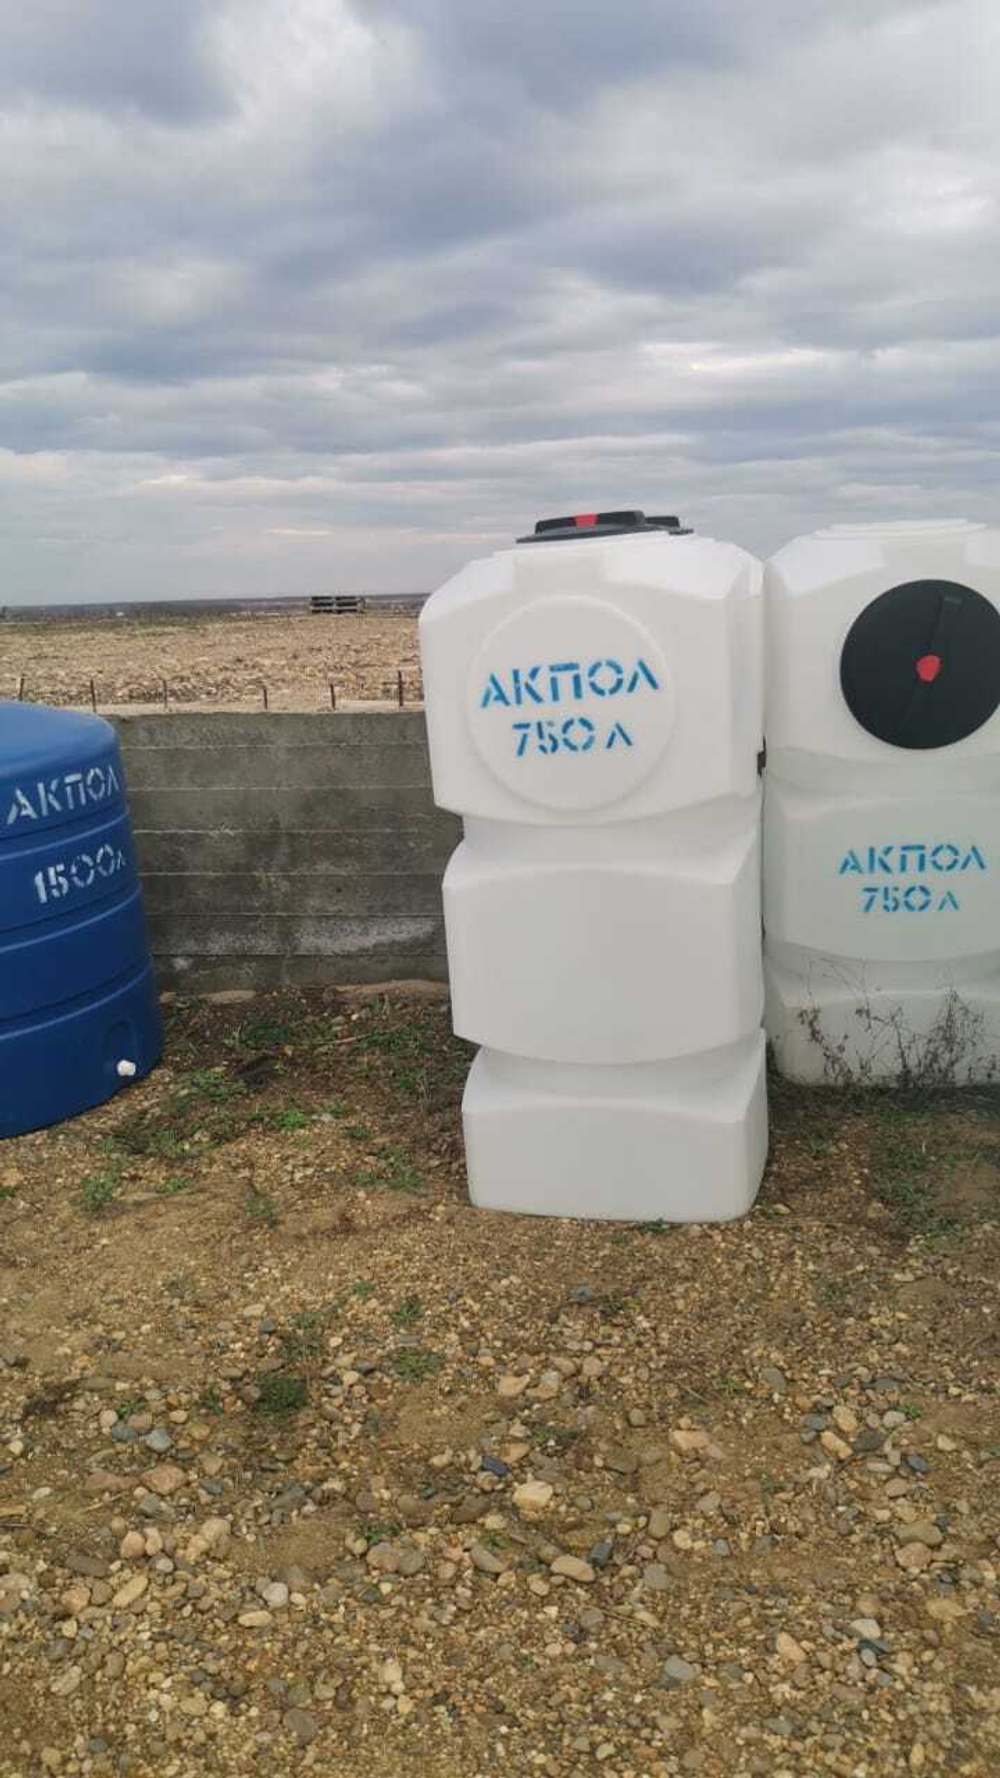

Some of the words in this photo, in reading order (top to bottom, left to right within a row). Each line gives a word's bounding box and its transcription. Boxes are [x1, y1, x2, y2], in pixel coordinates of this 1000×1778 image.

[480, 659, 660, 708] АКПОЛ
[512, 717, 595, 757] 750
[7, 766, 120, 824] АКПОЛ
[839, 844, 987, 875] АКПОЛ
[861, 885, 932, 912] 750
